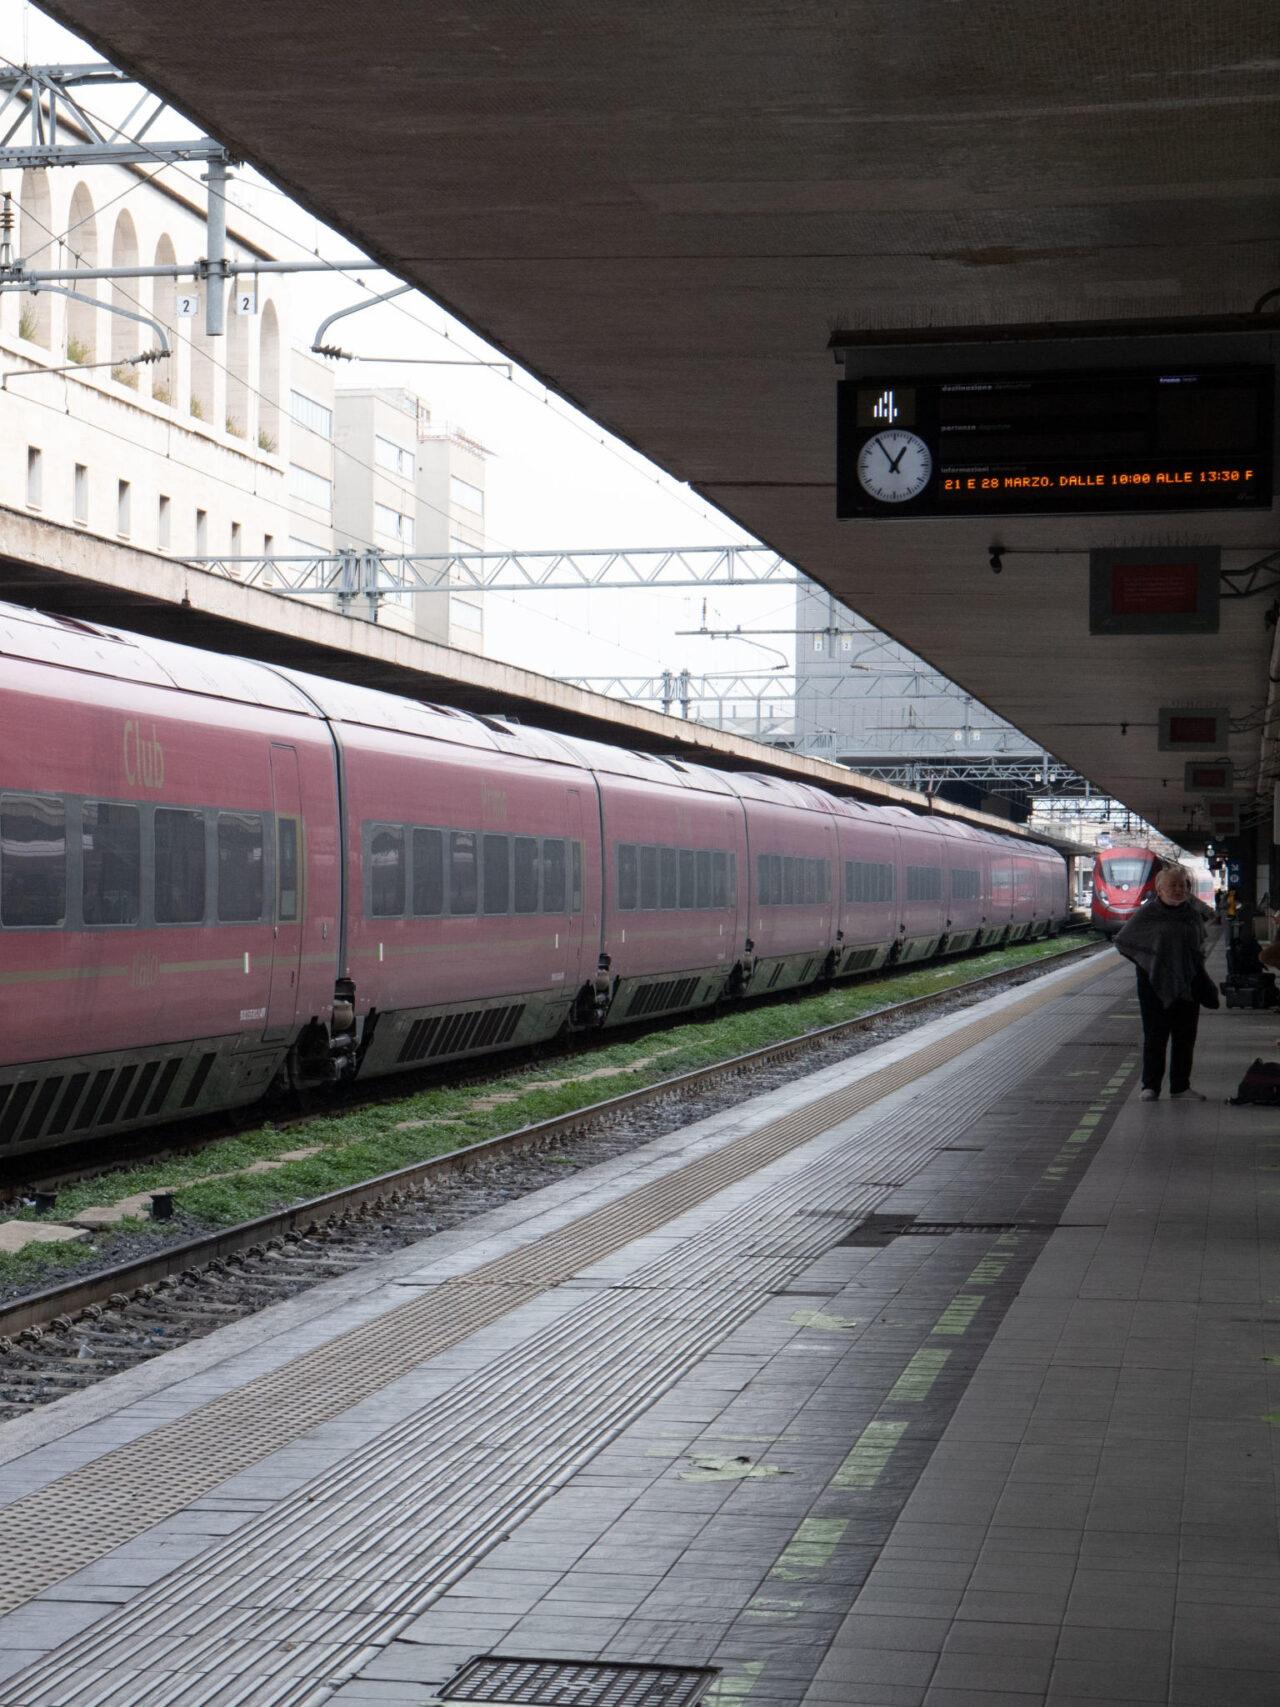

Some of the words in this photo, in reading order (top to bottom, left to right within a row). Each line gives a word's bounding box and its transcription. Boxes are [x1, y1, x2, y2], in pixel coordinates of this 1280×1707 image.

[183, 299, 190, 313] 2
[243, 297, 250, 311] 2
[944, 478, 961, 490] 21
[967, 477, 976, 489] E
[981, 477, 999, 489] 28
[1059, 474, 1105, 487] DALLE
[1111, 473, 1151, 486] 10:00
[1156, 471, 1192, 484] ALLE
[1199, 470, 1239, 483] 13:30
[123, 719, 165, 789] Club
